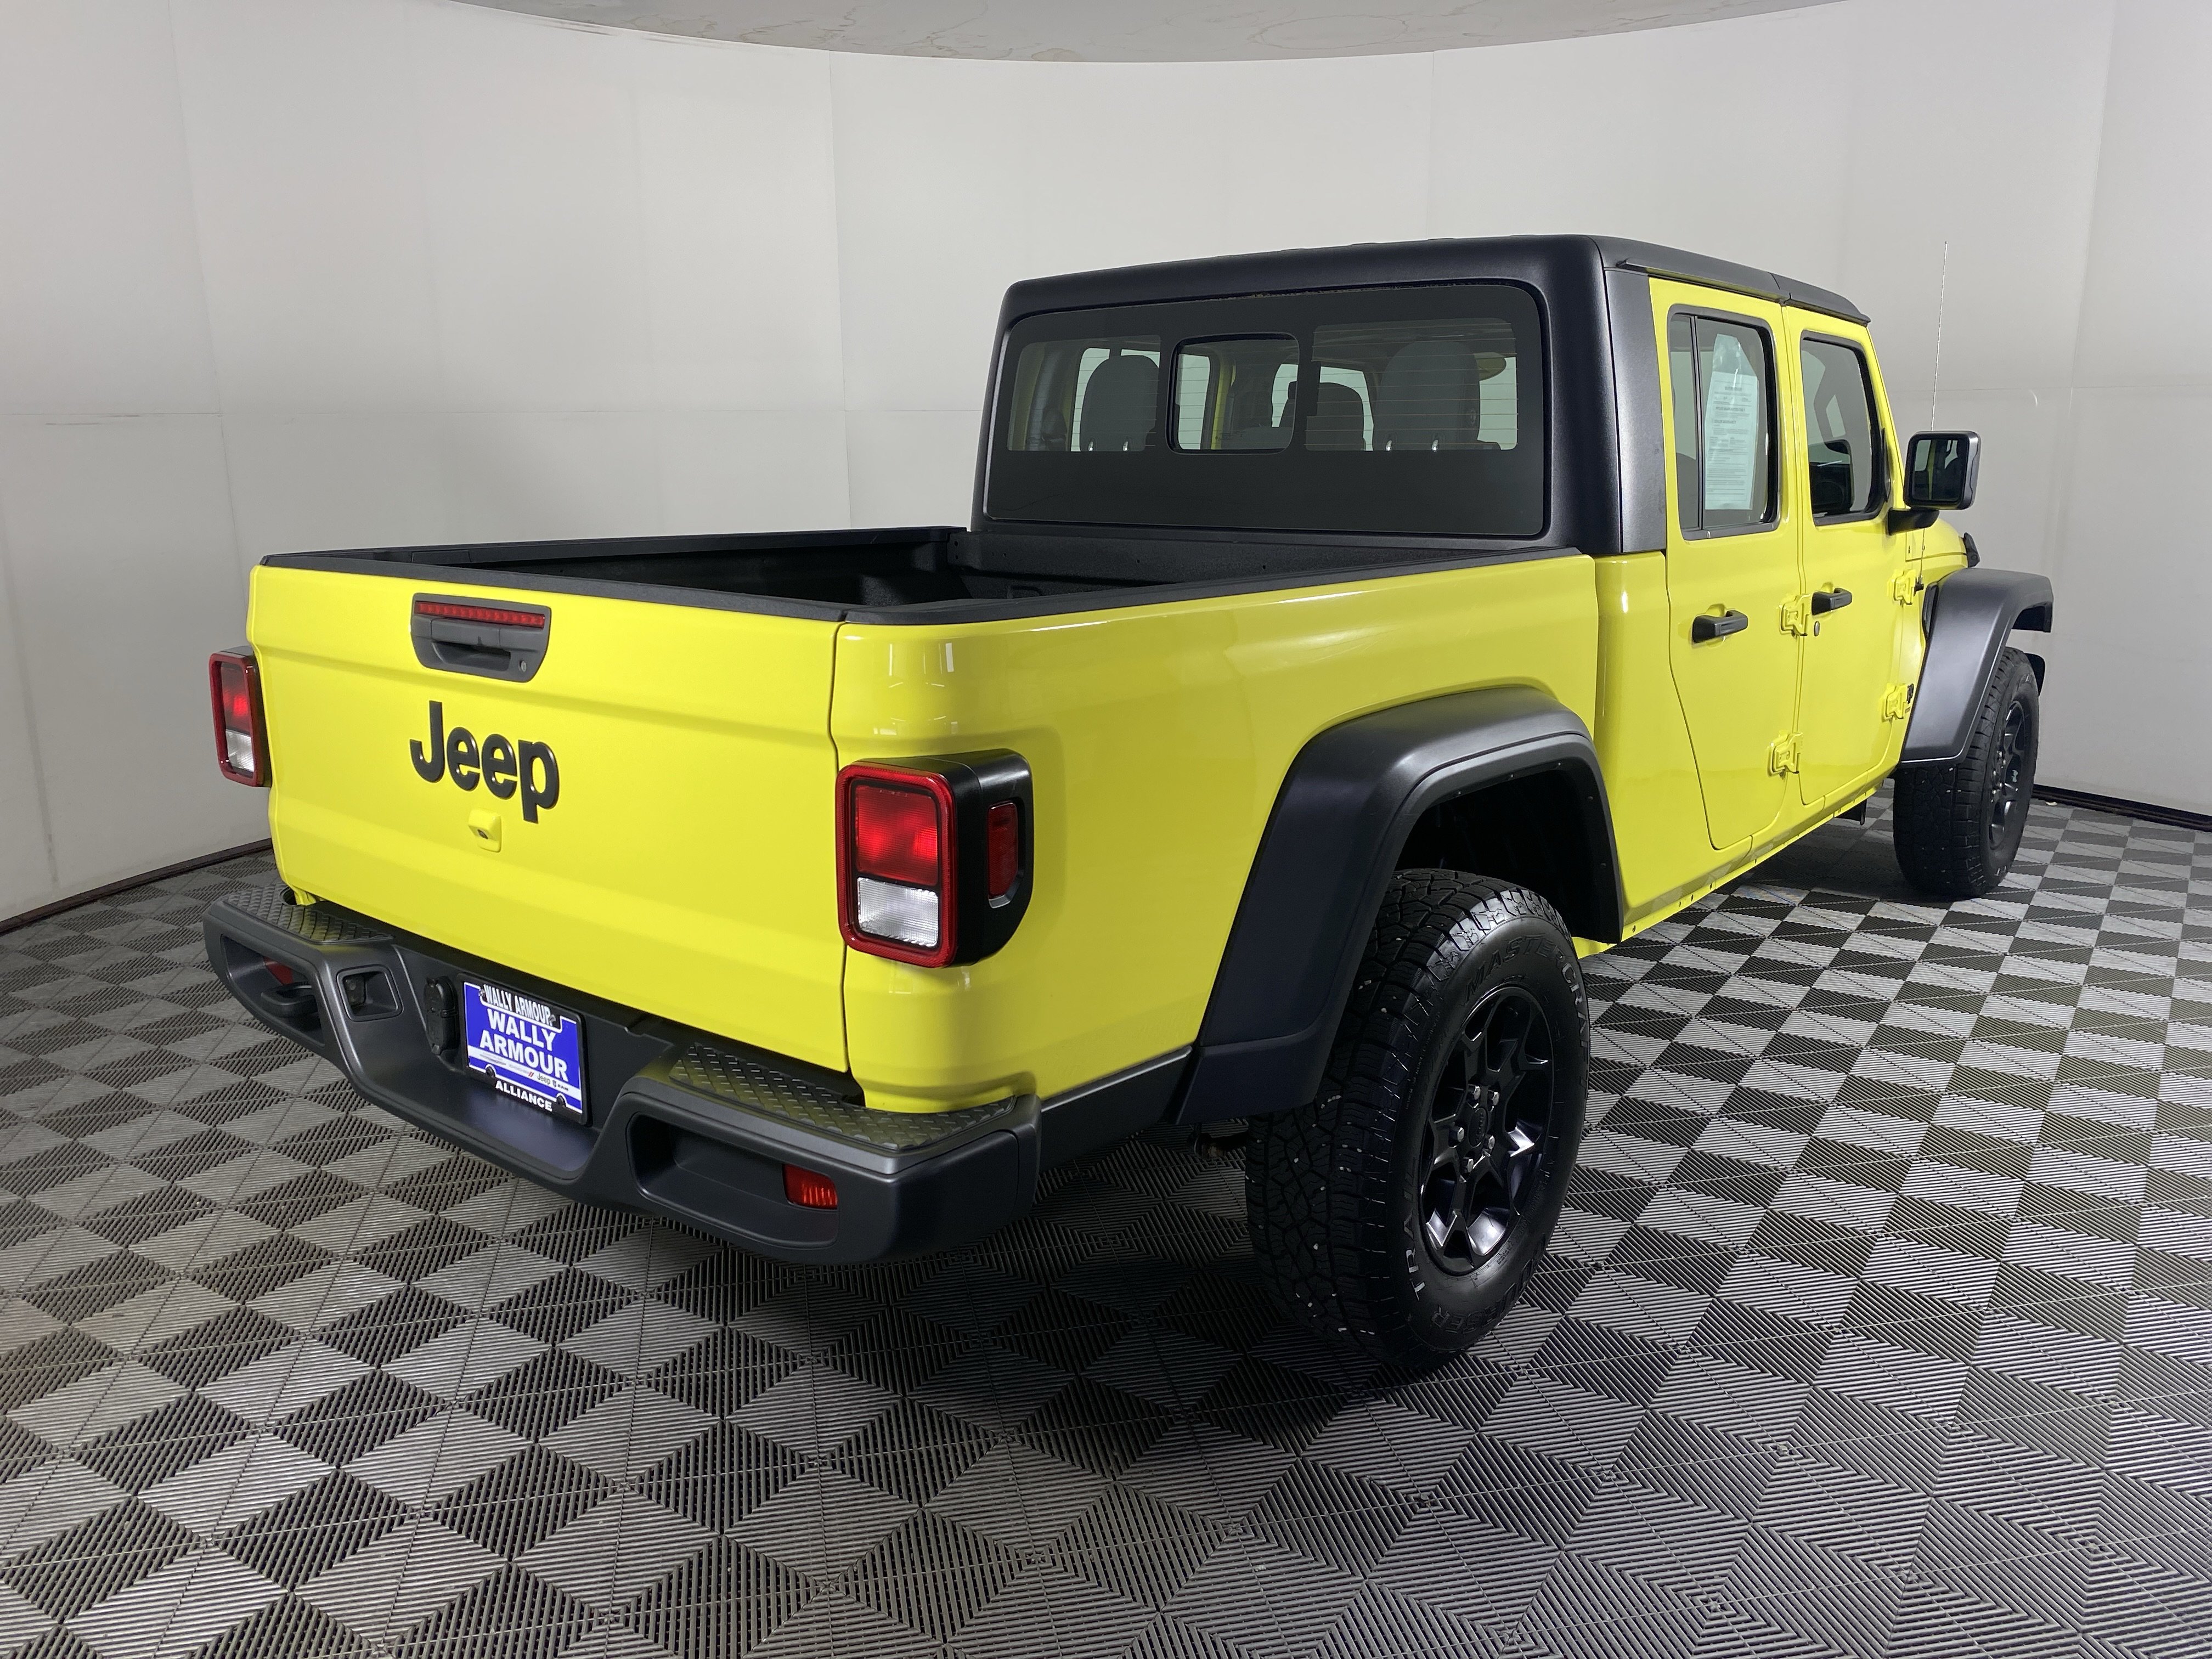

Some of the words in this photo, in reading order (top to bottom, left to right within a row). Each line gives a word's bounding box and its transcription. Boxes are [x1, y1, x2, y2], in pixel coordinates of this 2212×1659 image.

[409, 700, 560, 824] Jeep
[483, 984, 512, 1012] WALLY
[514, 995, 553, 1026] ARMOUR
[487, 1008, 556, 1052] WALLY
[479, 1029, 569, 1082] ARMOUR
[495, 1080, 553, 1112] ALLIANCE
[537, 1073, 551, 1085] Jeep
